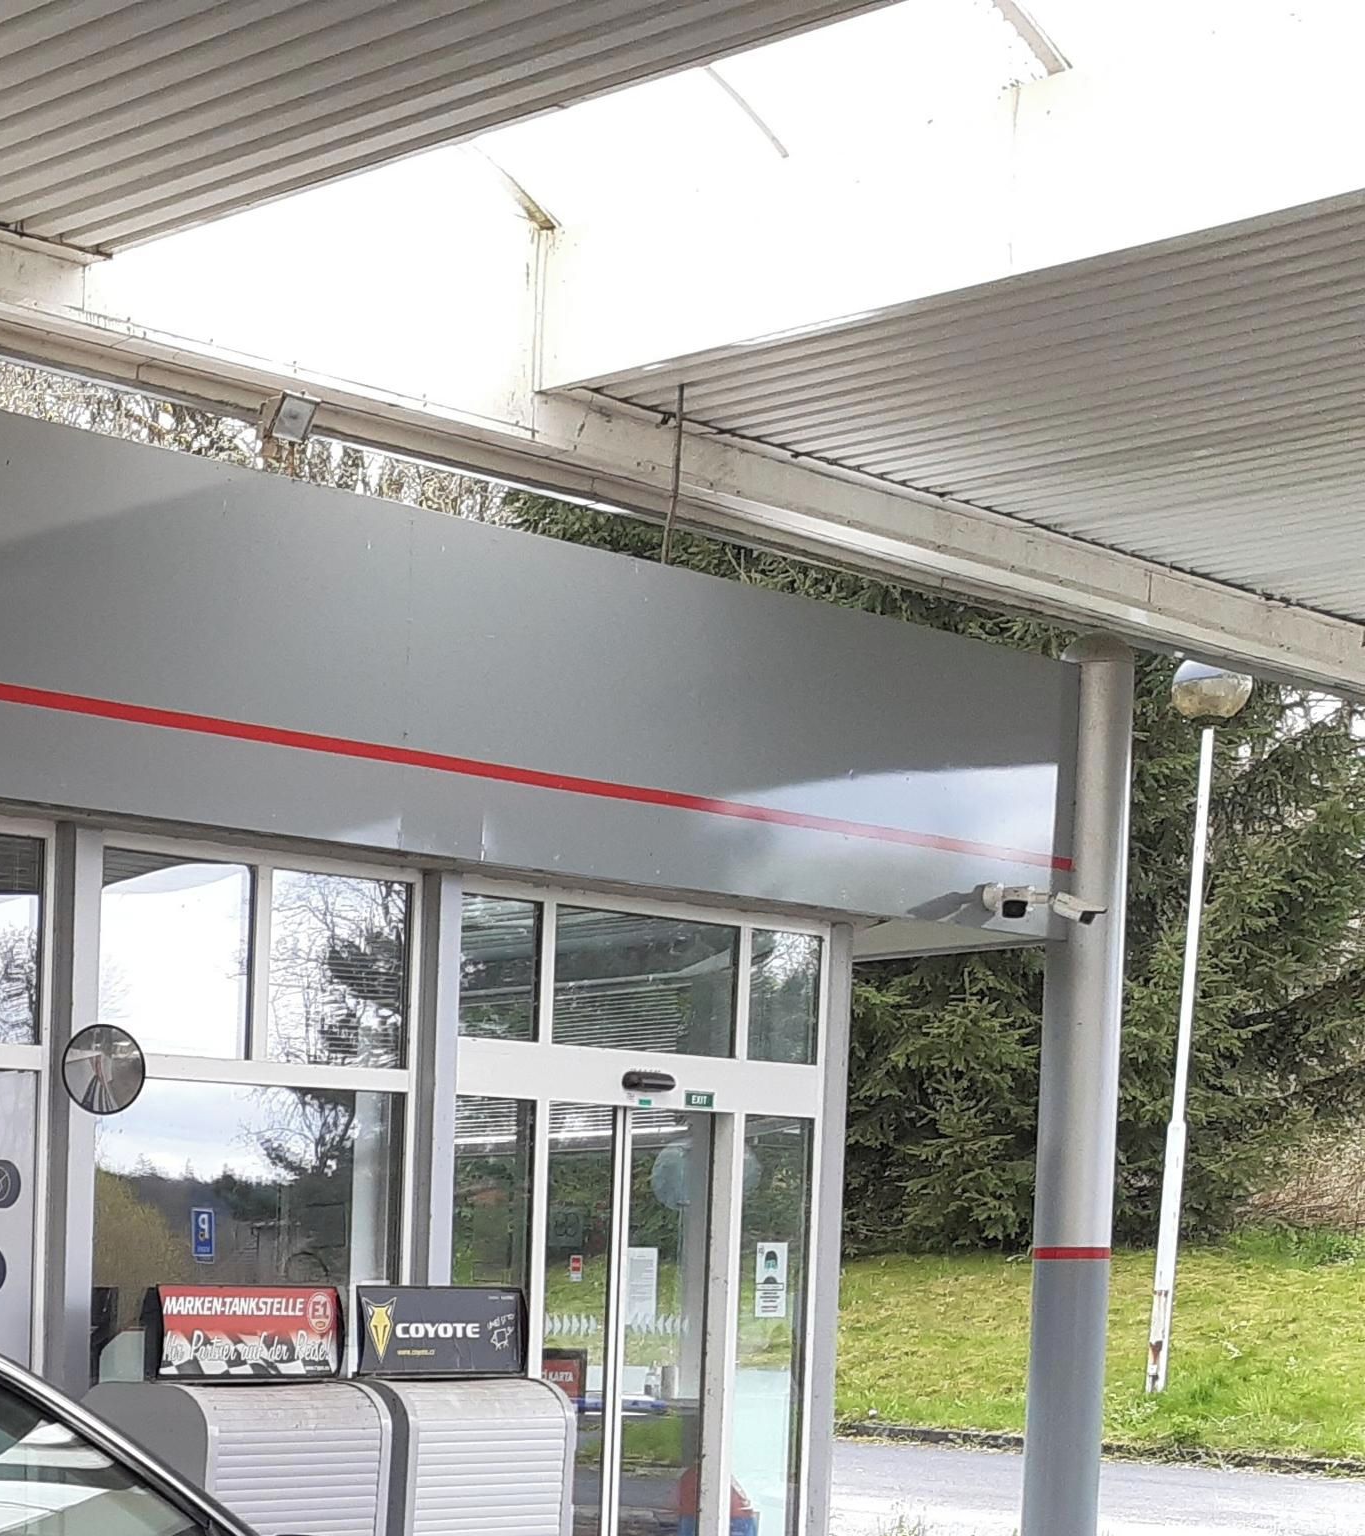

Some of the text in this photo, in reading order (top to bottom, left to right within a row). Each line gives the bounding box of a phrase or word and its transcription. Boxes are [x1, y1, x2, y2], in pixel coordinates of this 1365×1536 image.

[691, 1094, 708, 1105] EXIT
[162, 1296, 305, 1316] MARKEN-TANKSTELLE
[395, 1323, 480, 1339] COYOTE
[190, 1329, 237, 1362] Partner
[240, 1332, 268, 1361] auf
[270, 1334, 290, 1362] der
[294, 1329, 333, 1361] Reise!
[548, 1370, 574, 1383] KARTA
